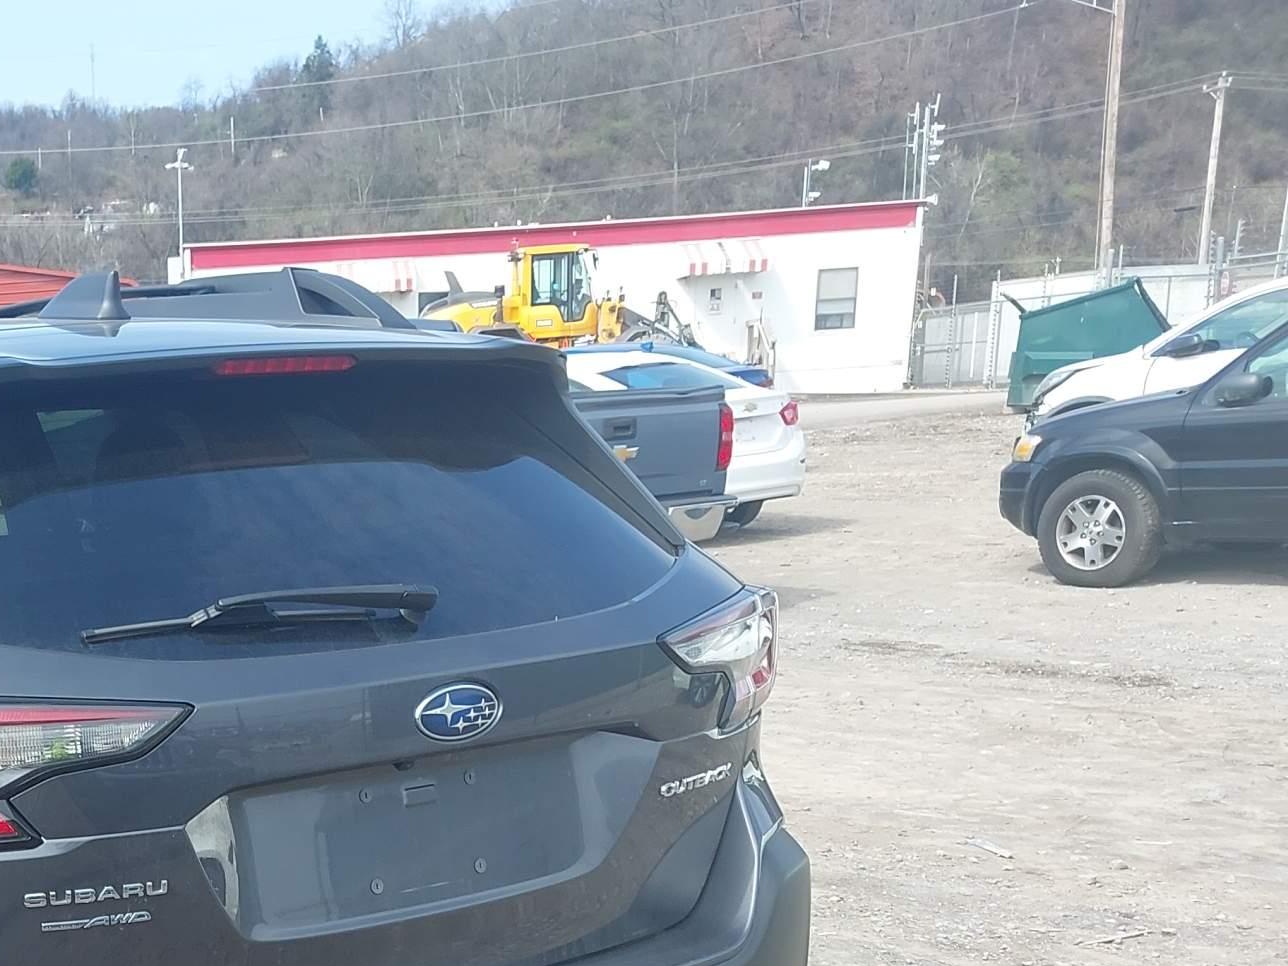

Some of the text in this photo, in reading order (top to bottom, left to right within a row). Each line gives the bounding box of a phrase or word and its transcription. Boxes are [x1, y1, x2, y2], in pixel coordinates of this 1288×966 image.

[660, 762, 732, 797] OUTBACK
[23, 879, 168, 908] SUBARU
[84, 911, 152, 928] AWD
